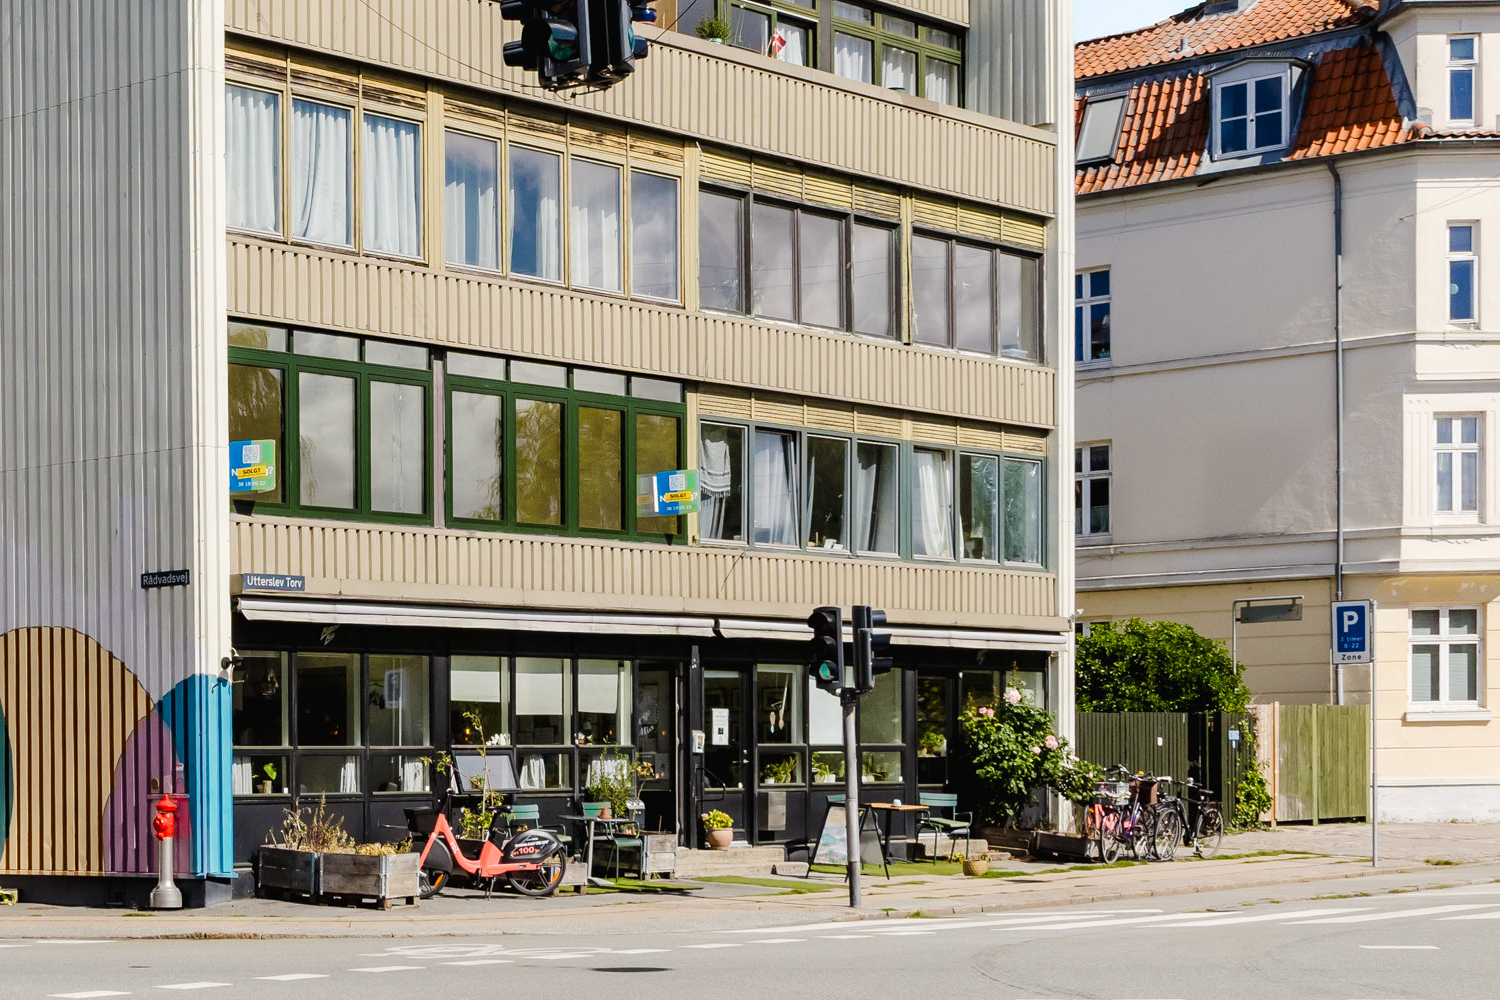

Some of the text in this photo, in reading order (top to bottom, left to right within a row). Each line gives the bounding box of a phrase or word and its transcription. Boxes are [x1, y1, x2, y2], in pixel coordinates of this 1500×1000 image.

[143, 571, 188, 585] Rådvadsvej
[247, 575, 302, 588] Utterslev Torv
[1343, 611, 1358, 632] P
[519, 846, 535, 854] 100
